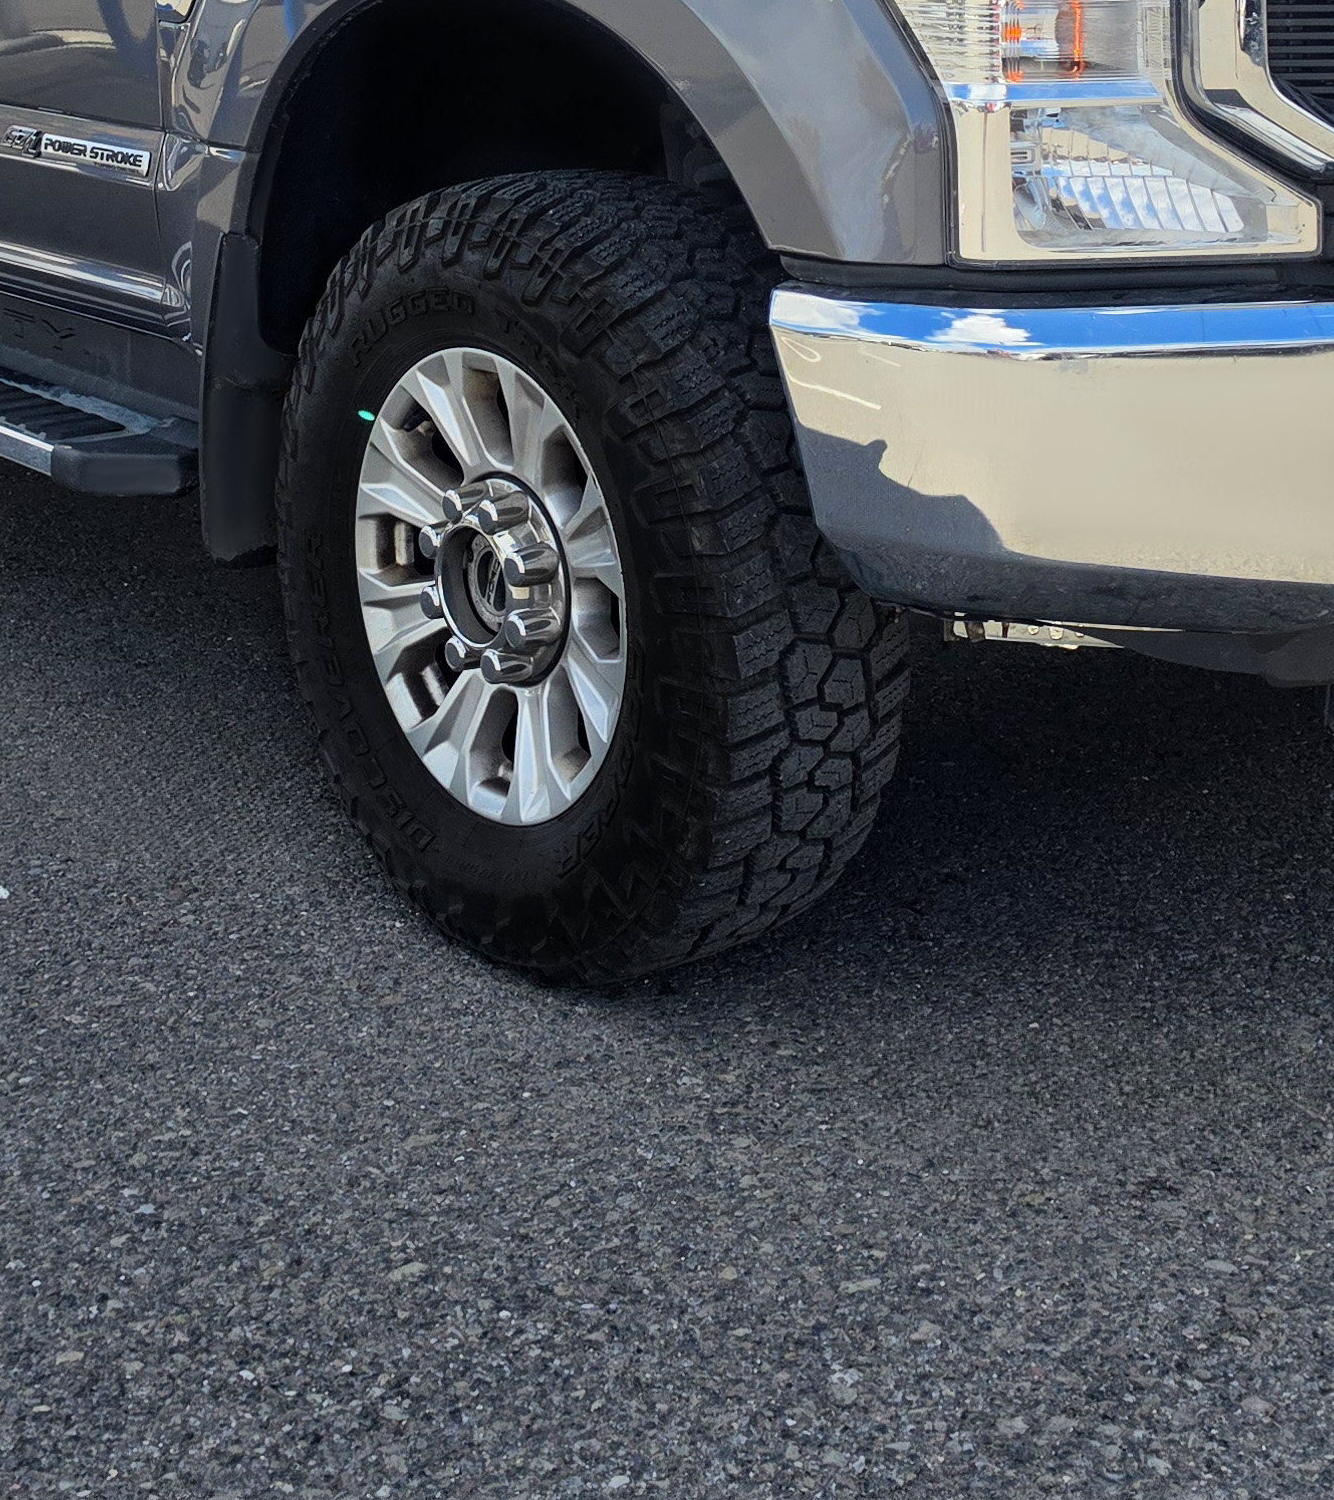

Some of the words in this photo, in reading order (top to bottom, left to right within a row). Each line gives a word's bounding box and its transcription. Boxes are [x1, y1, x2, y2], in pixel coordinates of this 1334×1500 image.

[44, 137, 87, 157] POWER
[89, 146, 143, 168] STROKE
[351, 286, 475, 367] RUGGED
